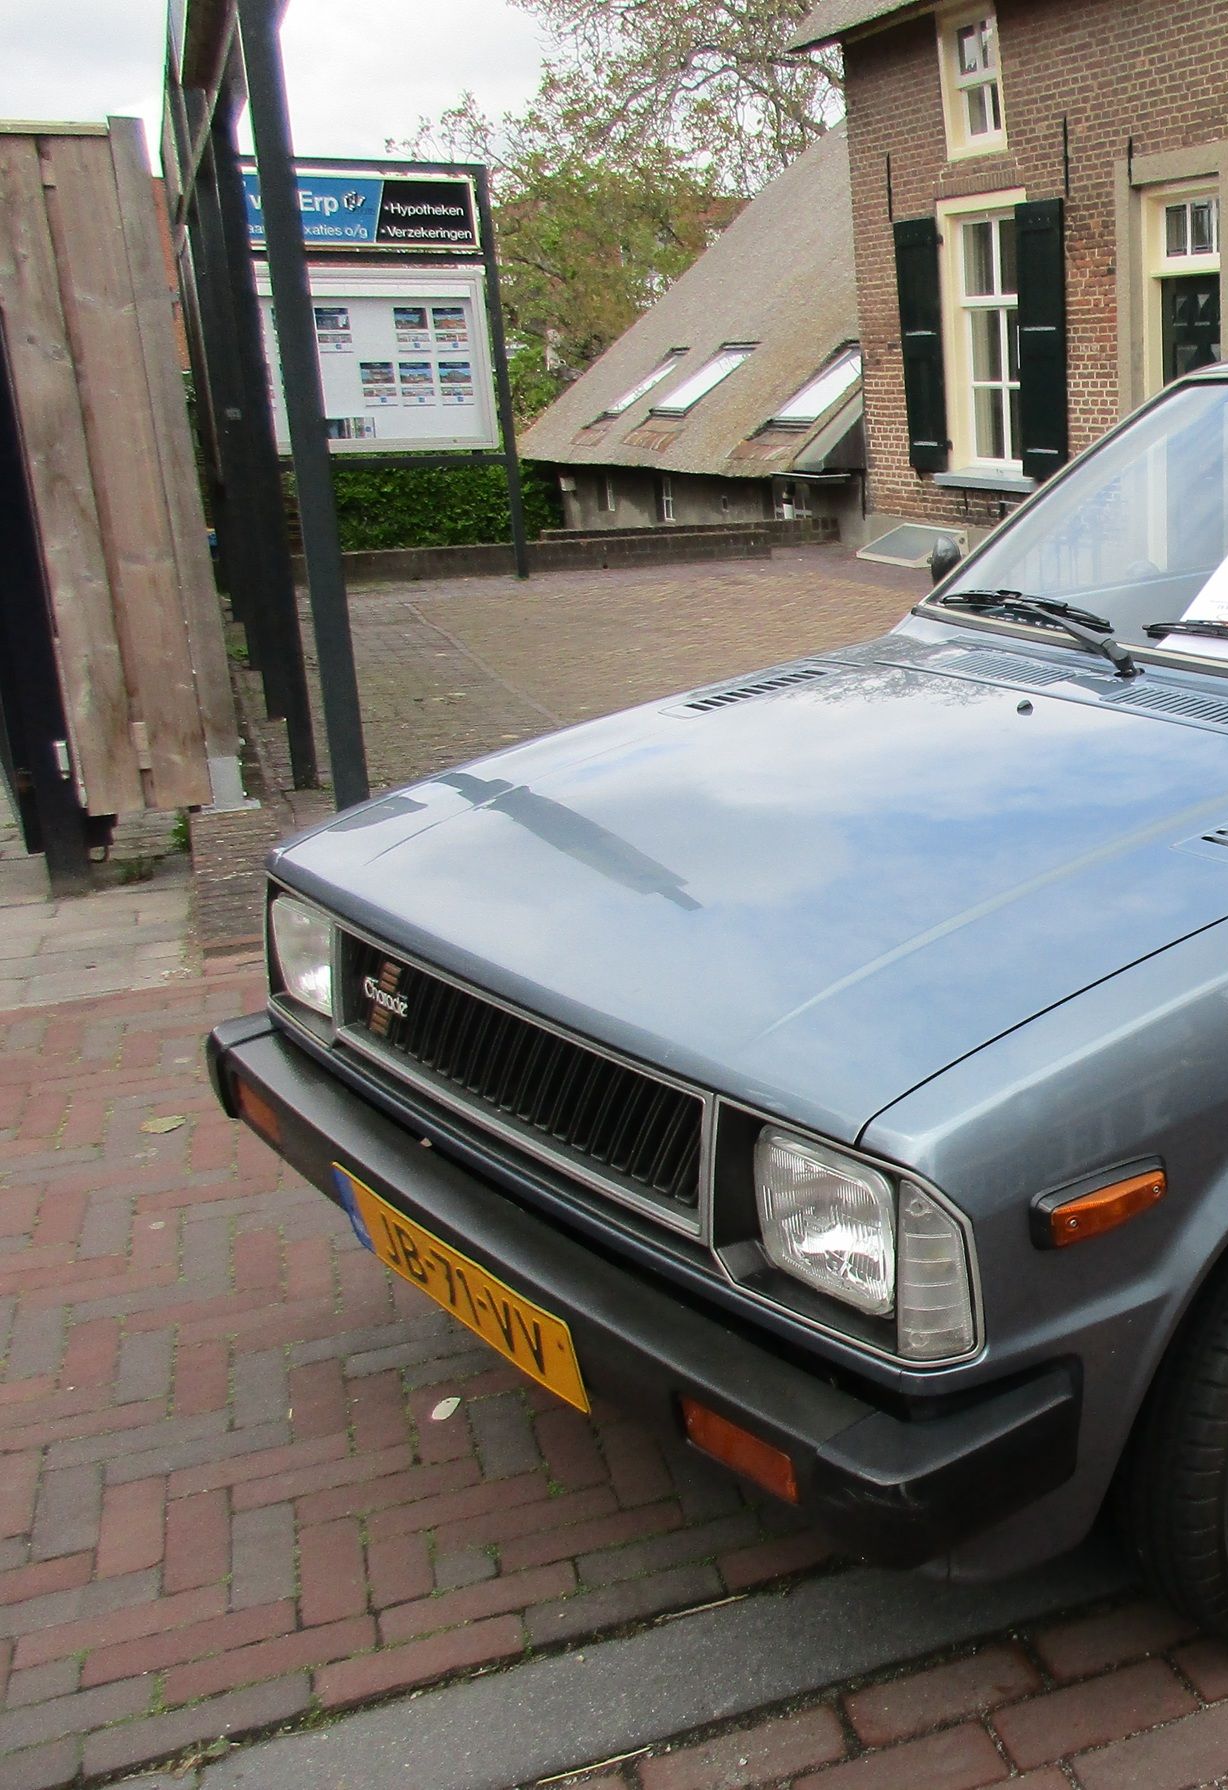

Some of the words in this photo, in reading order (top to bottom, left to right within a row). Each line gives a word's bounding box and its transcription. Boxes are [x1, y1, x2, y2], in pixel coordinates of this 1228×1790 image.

[298, 190, 339, 216] Erp
[390, 202, 465, 217] Hypotheken
[304, 224, 343, 237] xaties
[345, 223, 368, 239] o/g
[386, 225, 473, 241] Verzekeringen
[363, 975, 409, 1018] Charade
[379, 1210, 547, 1377] JB-71-VV
